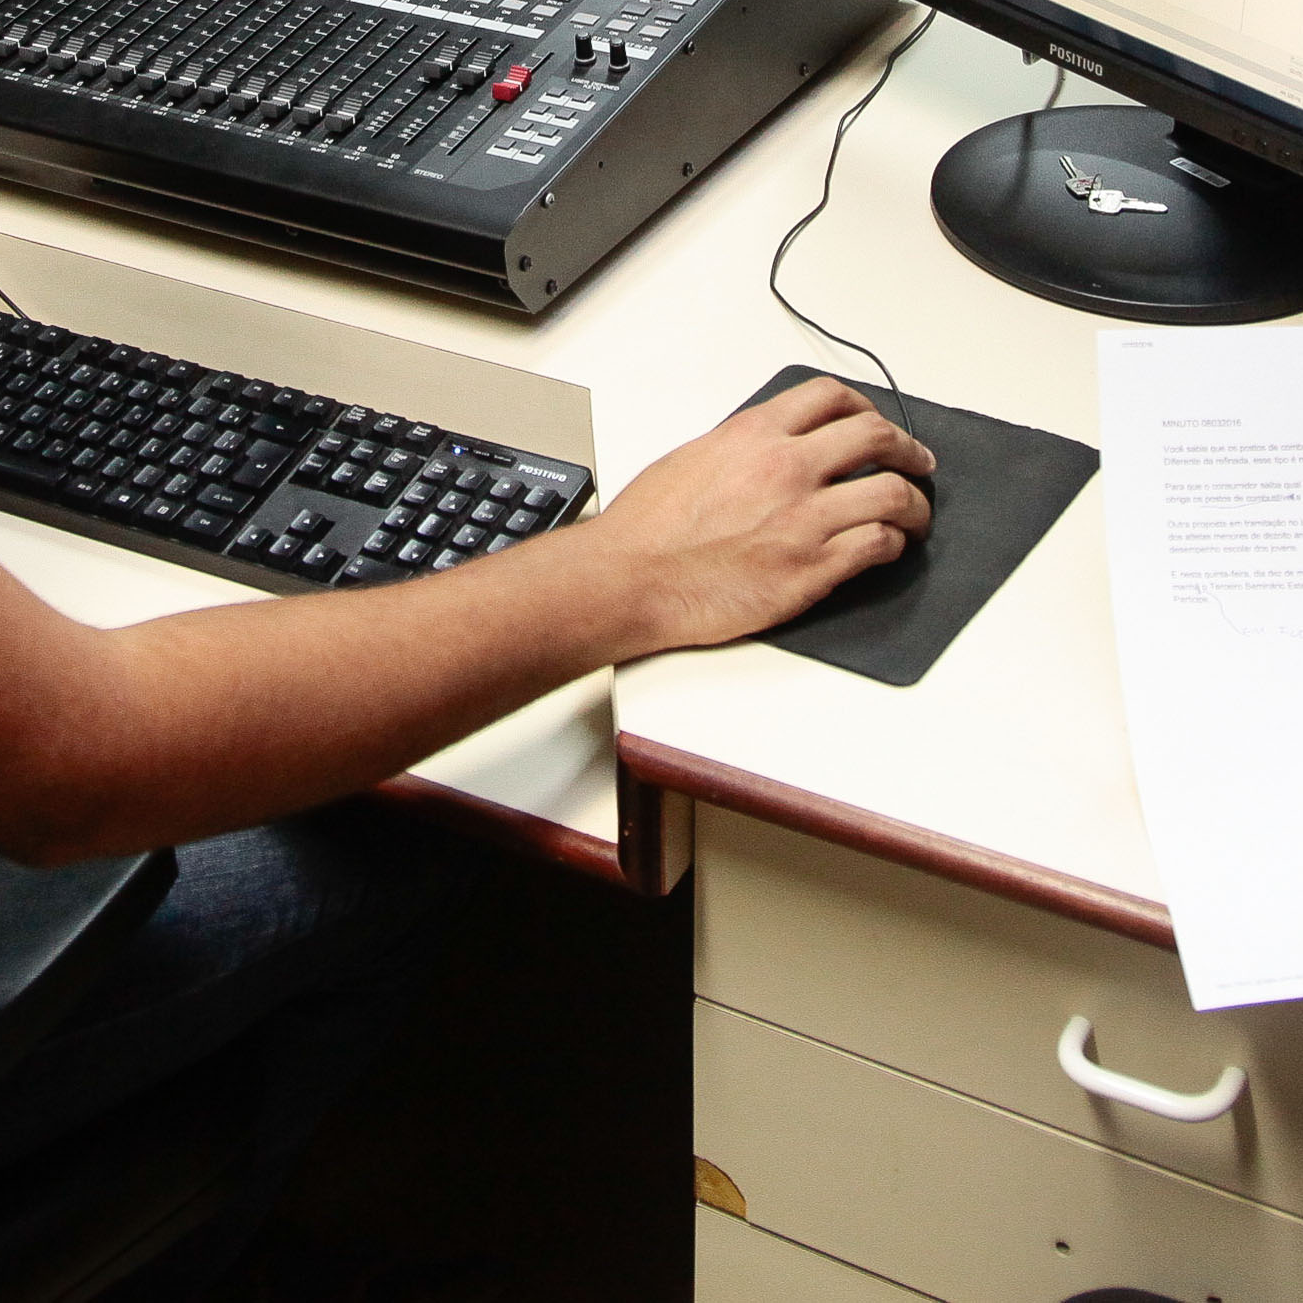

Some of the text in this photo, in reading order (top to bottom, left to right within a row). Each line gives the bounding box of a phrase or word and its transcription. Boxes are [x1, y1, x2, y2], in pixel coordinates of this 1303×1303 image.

[1049, 43, 1103, 76] POSITIVO
[413, 168, 444, 180] STEREO
[517, 463, 567, 483] POSITIVO
